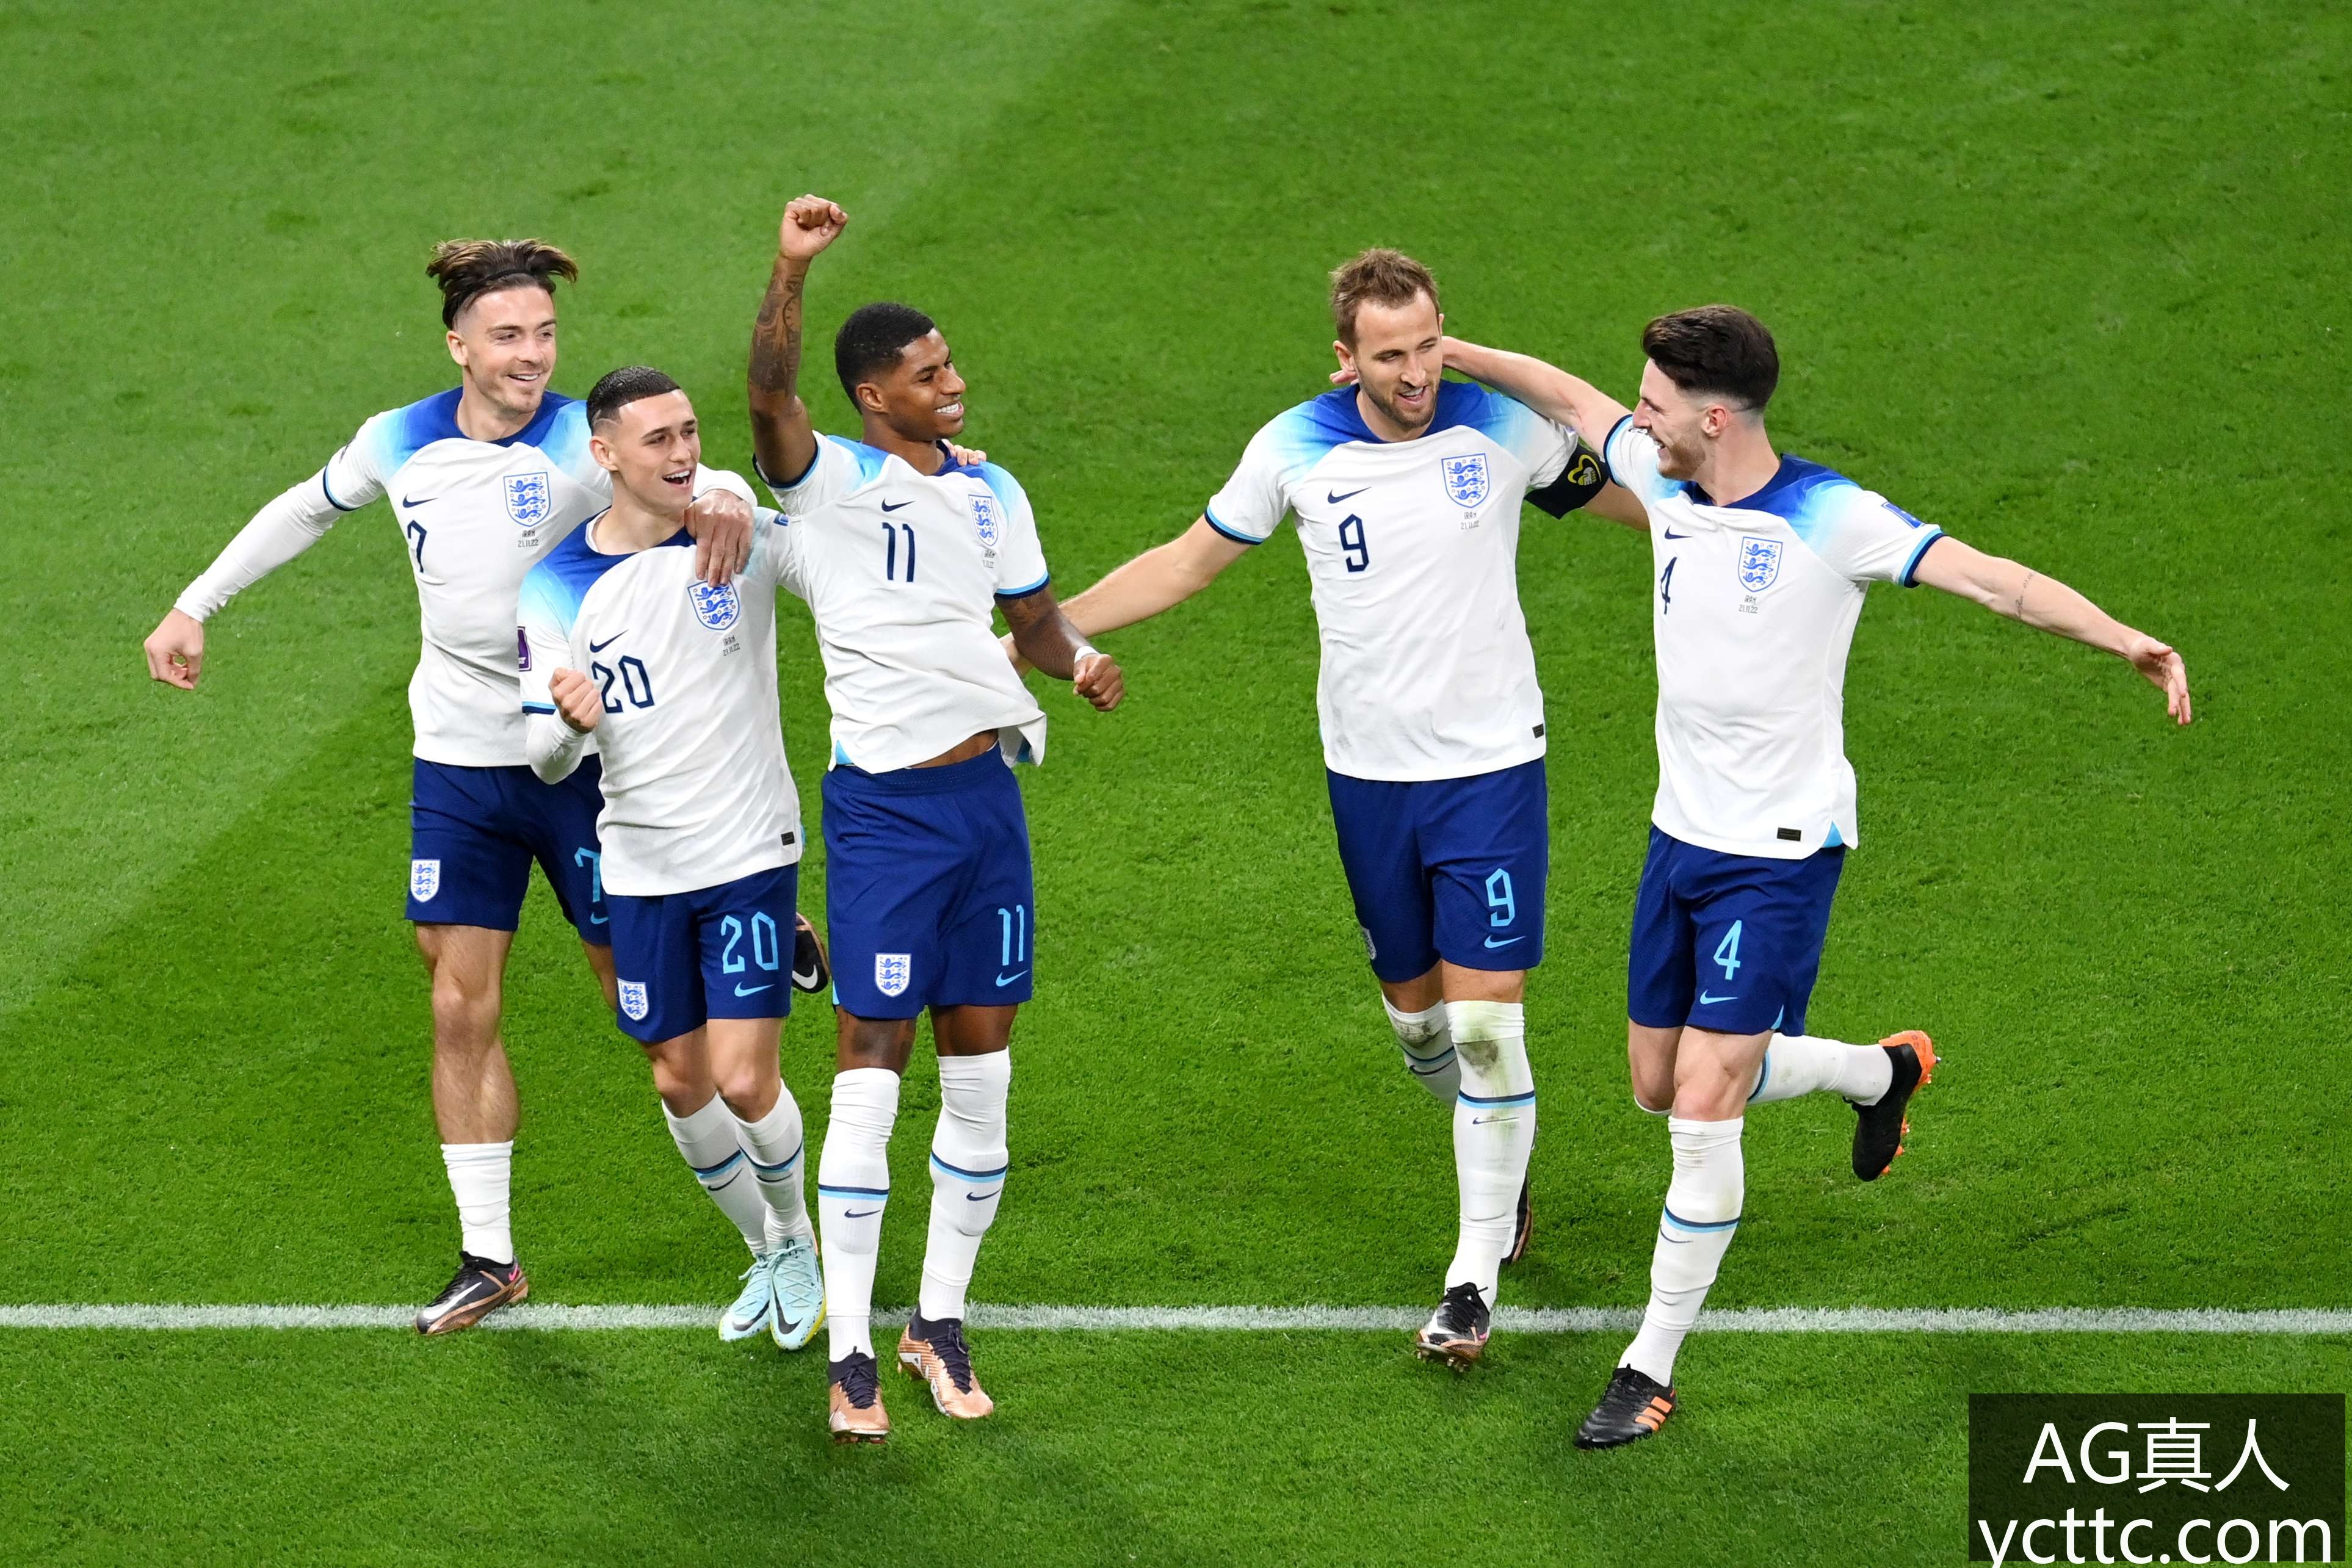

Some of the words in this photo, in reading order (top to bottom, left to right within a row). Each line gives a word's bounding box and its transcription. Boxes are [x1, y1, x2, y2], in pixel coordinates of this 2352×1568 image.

[408, 519, 427, 574] 7
[882, 522, 916, 582] 11
[1339, 514, 1369, 572] 9
[1660, 557, 1677, 615] 4
[591, 655, 655, 714] 20
[574, 847, 601, 903] 7
[1485, 868, 1515, 927] 9
[720, 911, 779, 975] 20
[997, 904, 1024, 966] 11
[1713, 919, 1742, 981] 4
